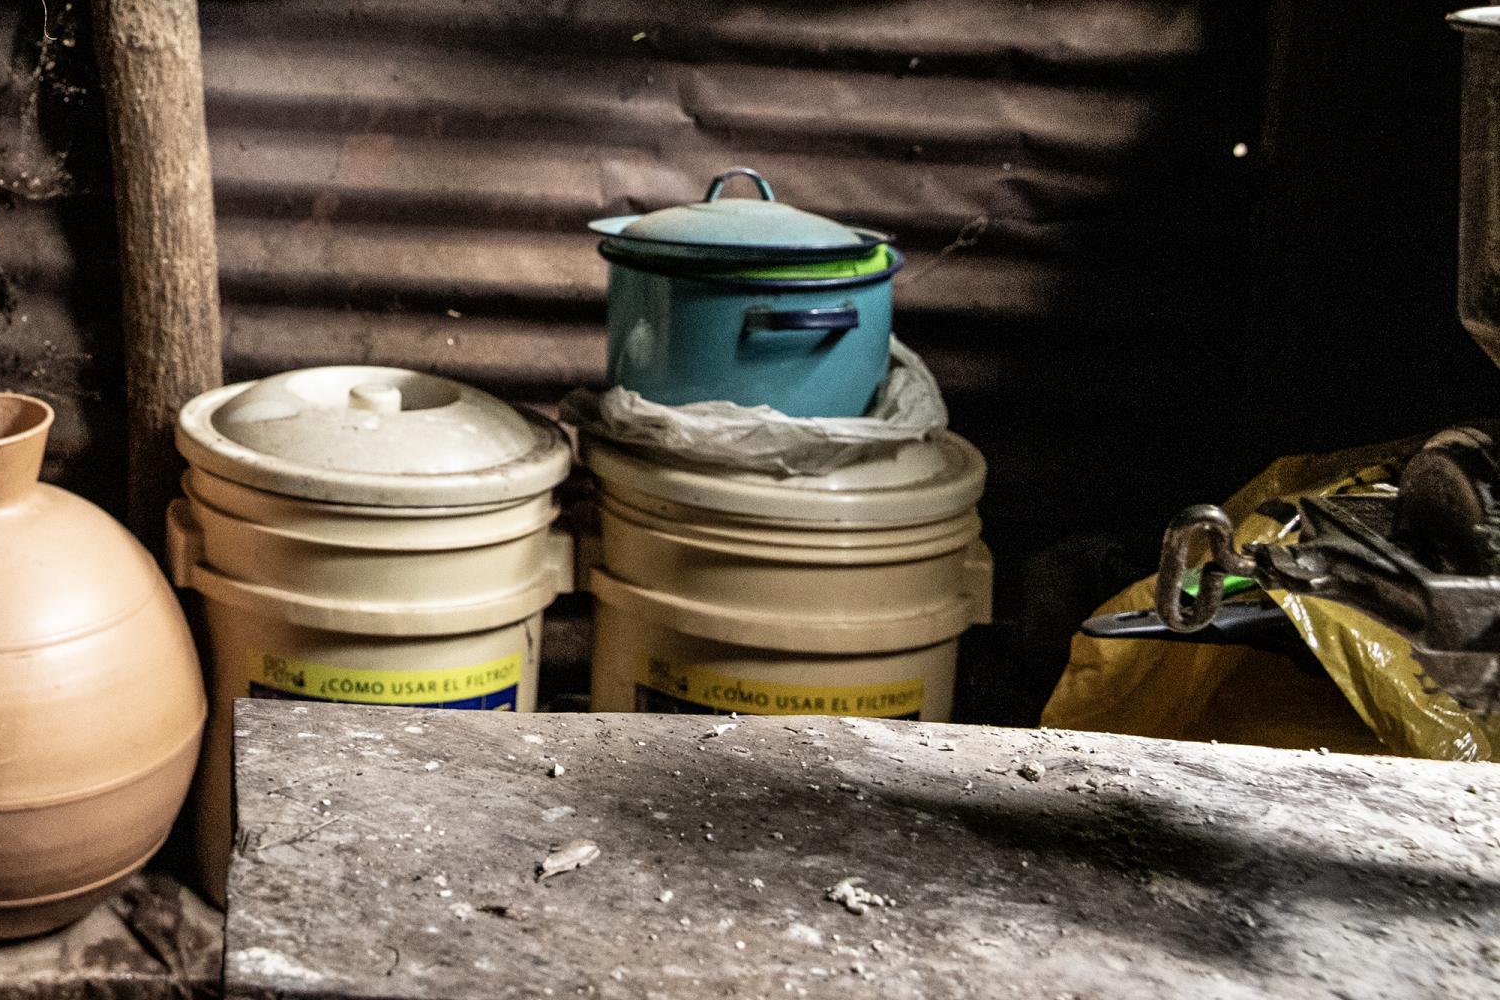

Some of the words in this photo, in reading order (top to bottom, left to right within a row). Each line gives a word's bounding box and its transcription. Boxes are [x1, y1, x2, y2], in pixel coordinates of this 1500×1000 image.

[392, 681, 437, 696] USAR
[444, 679, 460, 693] EL
[775, 695, 825, 711] USAR
[831, 698, 850, 712] EL
